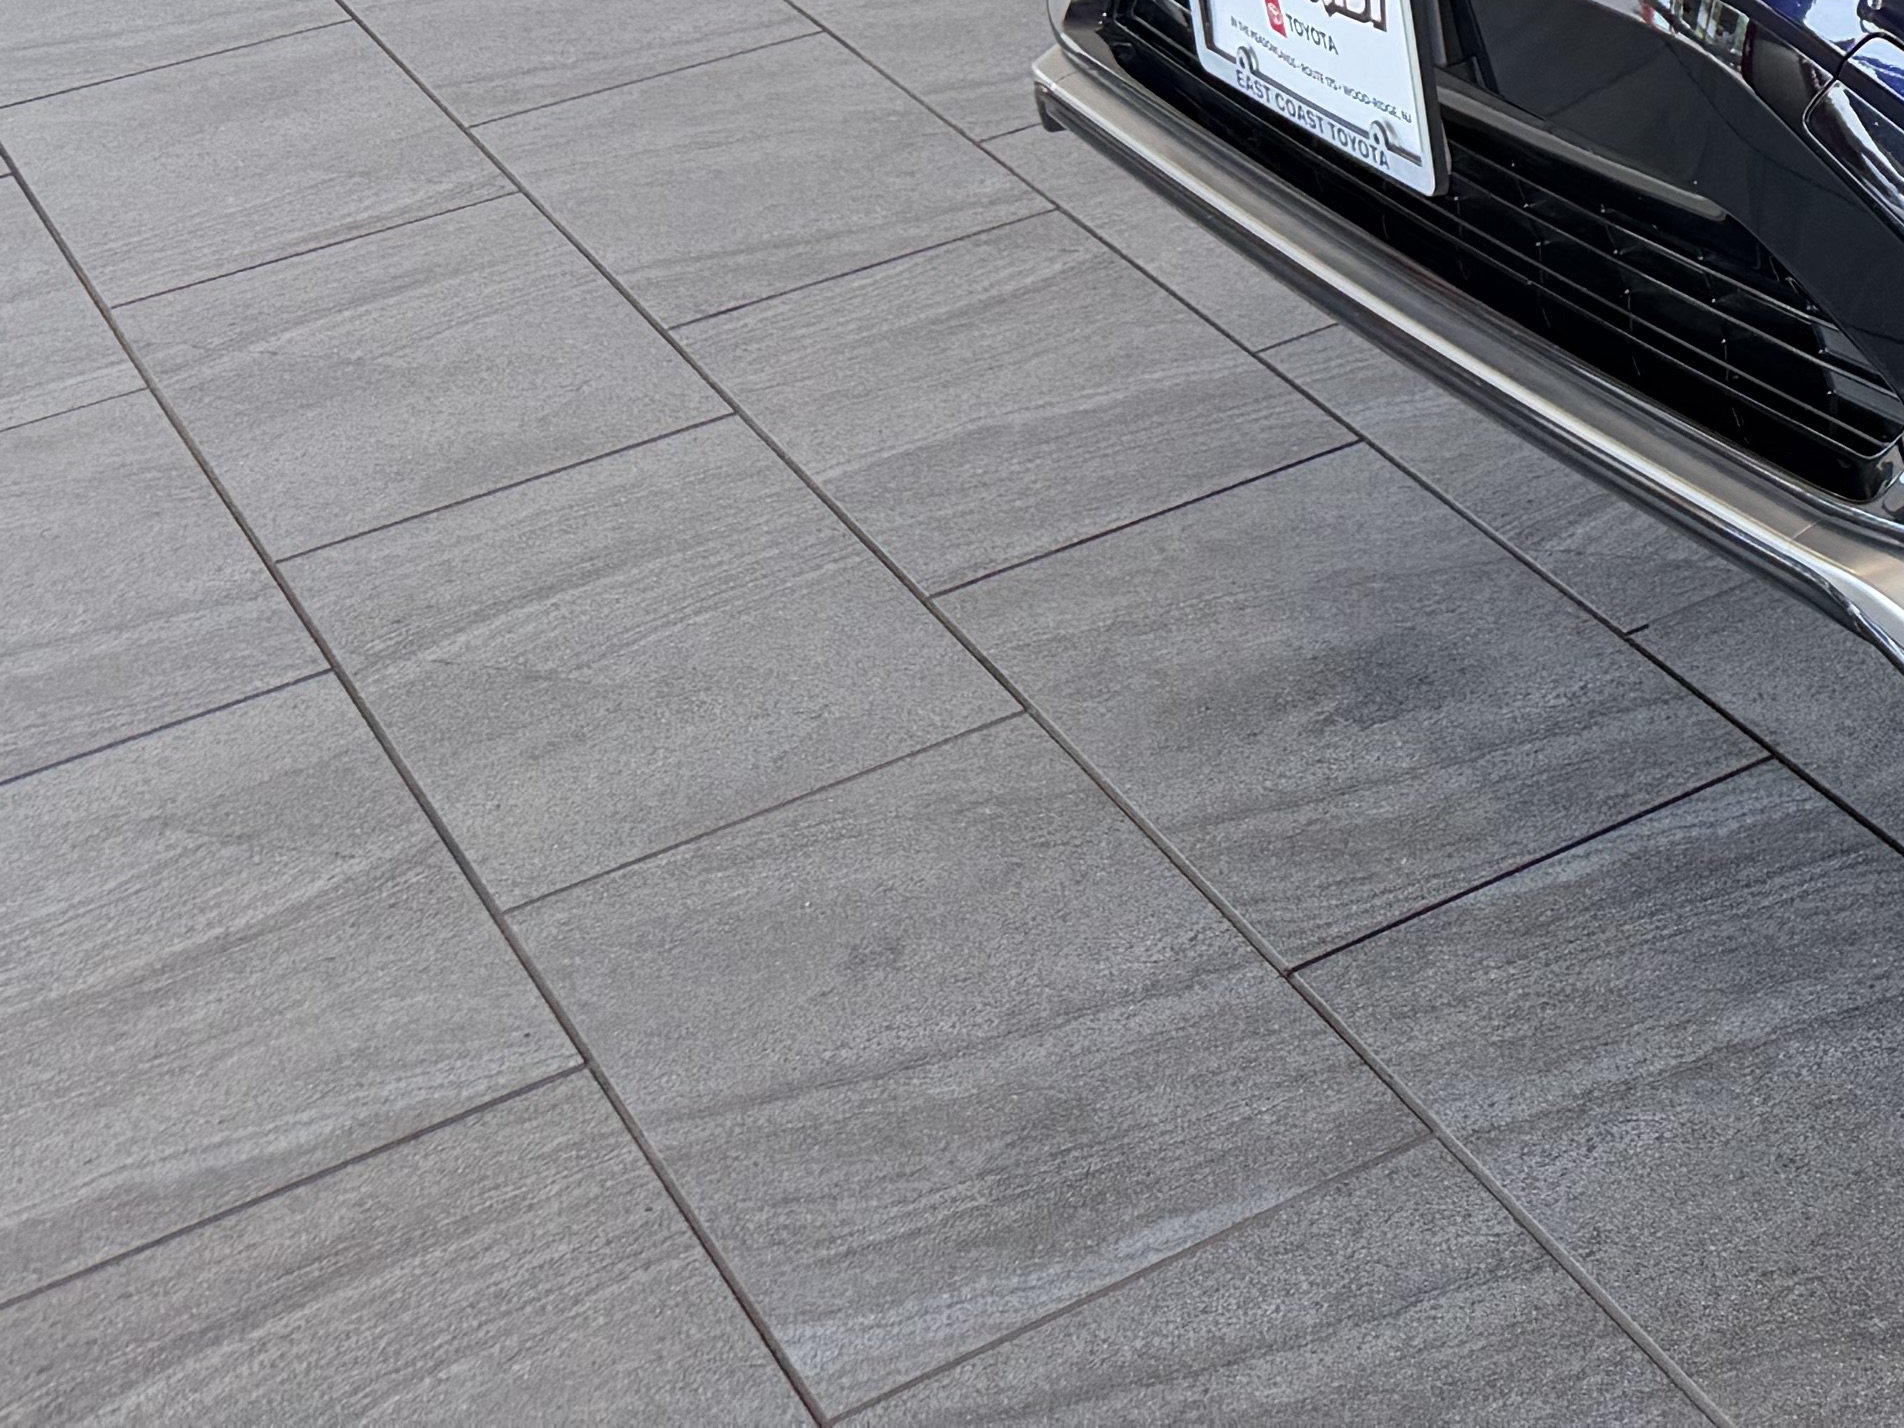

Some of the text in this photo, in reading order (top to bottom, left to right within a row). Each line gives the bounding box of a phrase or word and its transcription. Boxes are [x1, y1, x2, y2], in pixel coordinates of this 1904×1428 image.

[1285, 13, 1339, 55] TOYOTA
[1236, 69, 1390, 170] EAST COAST TOYOTA
